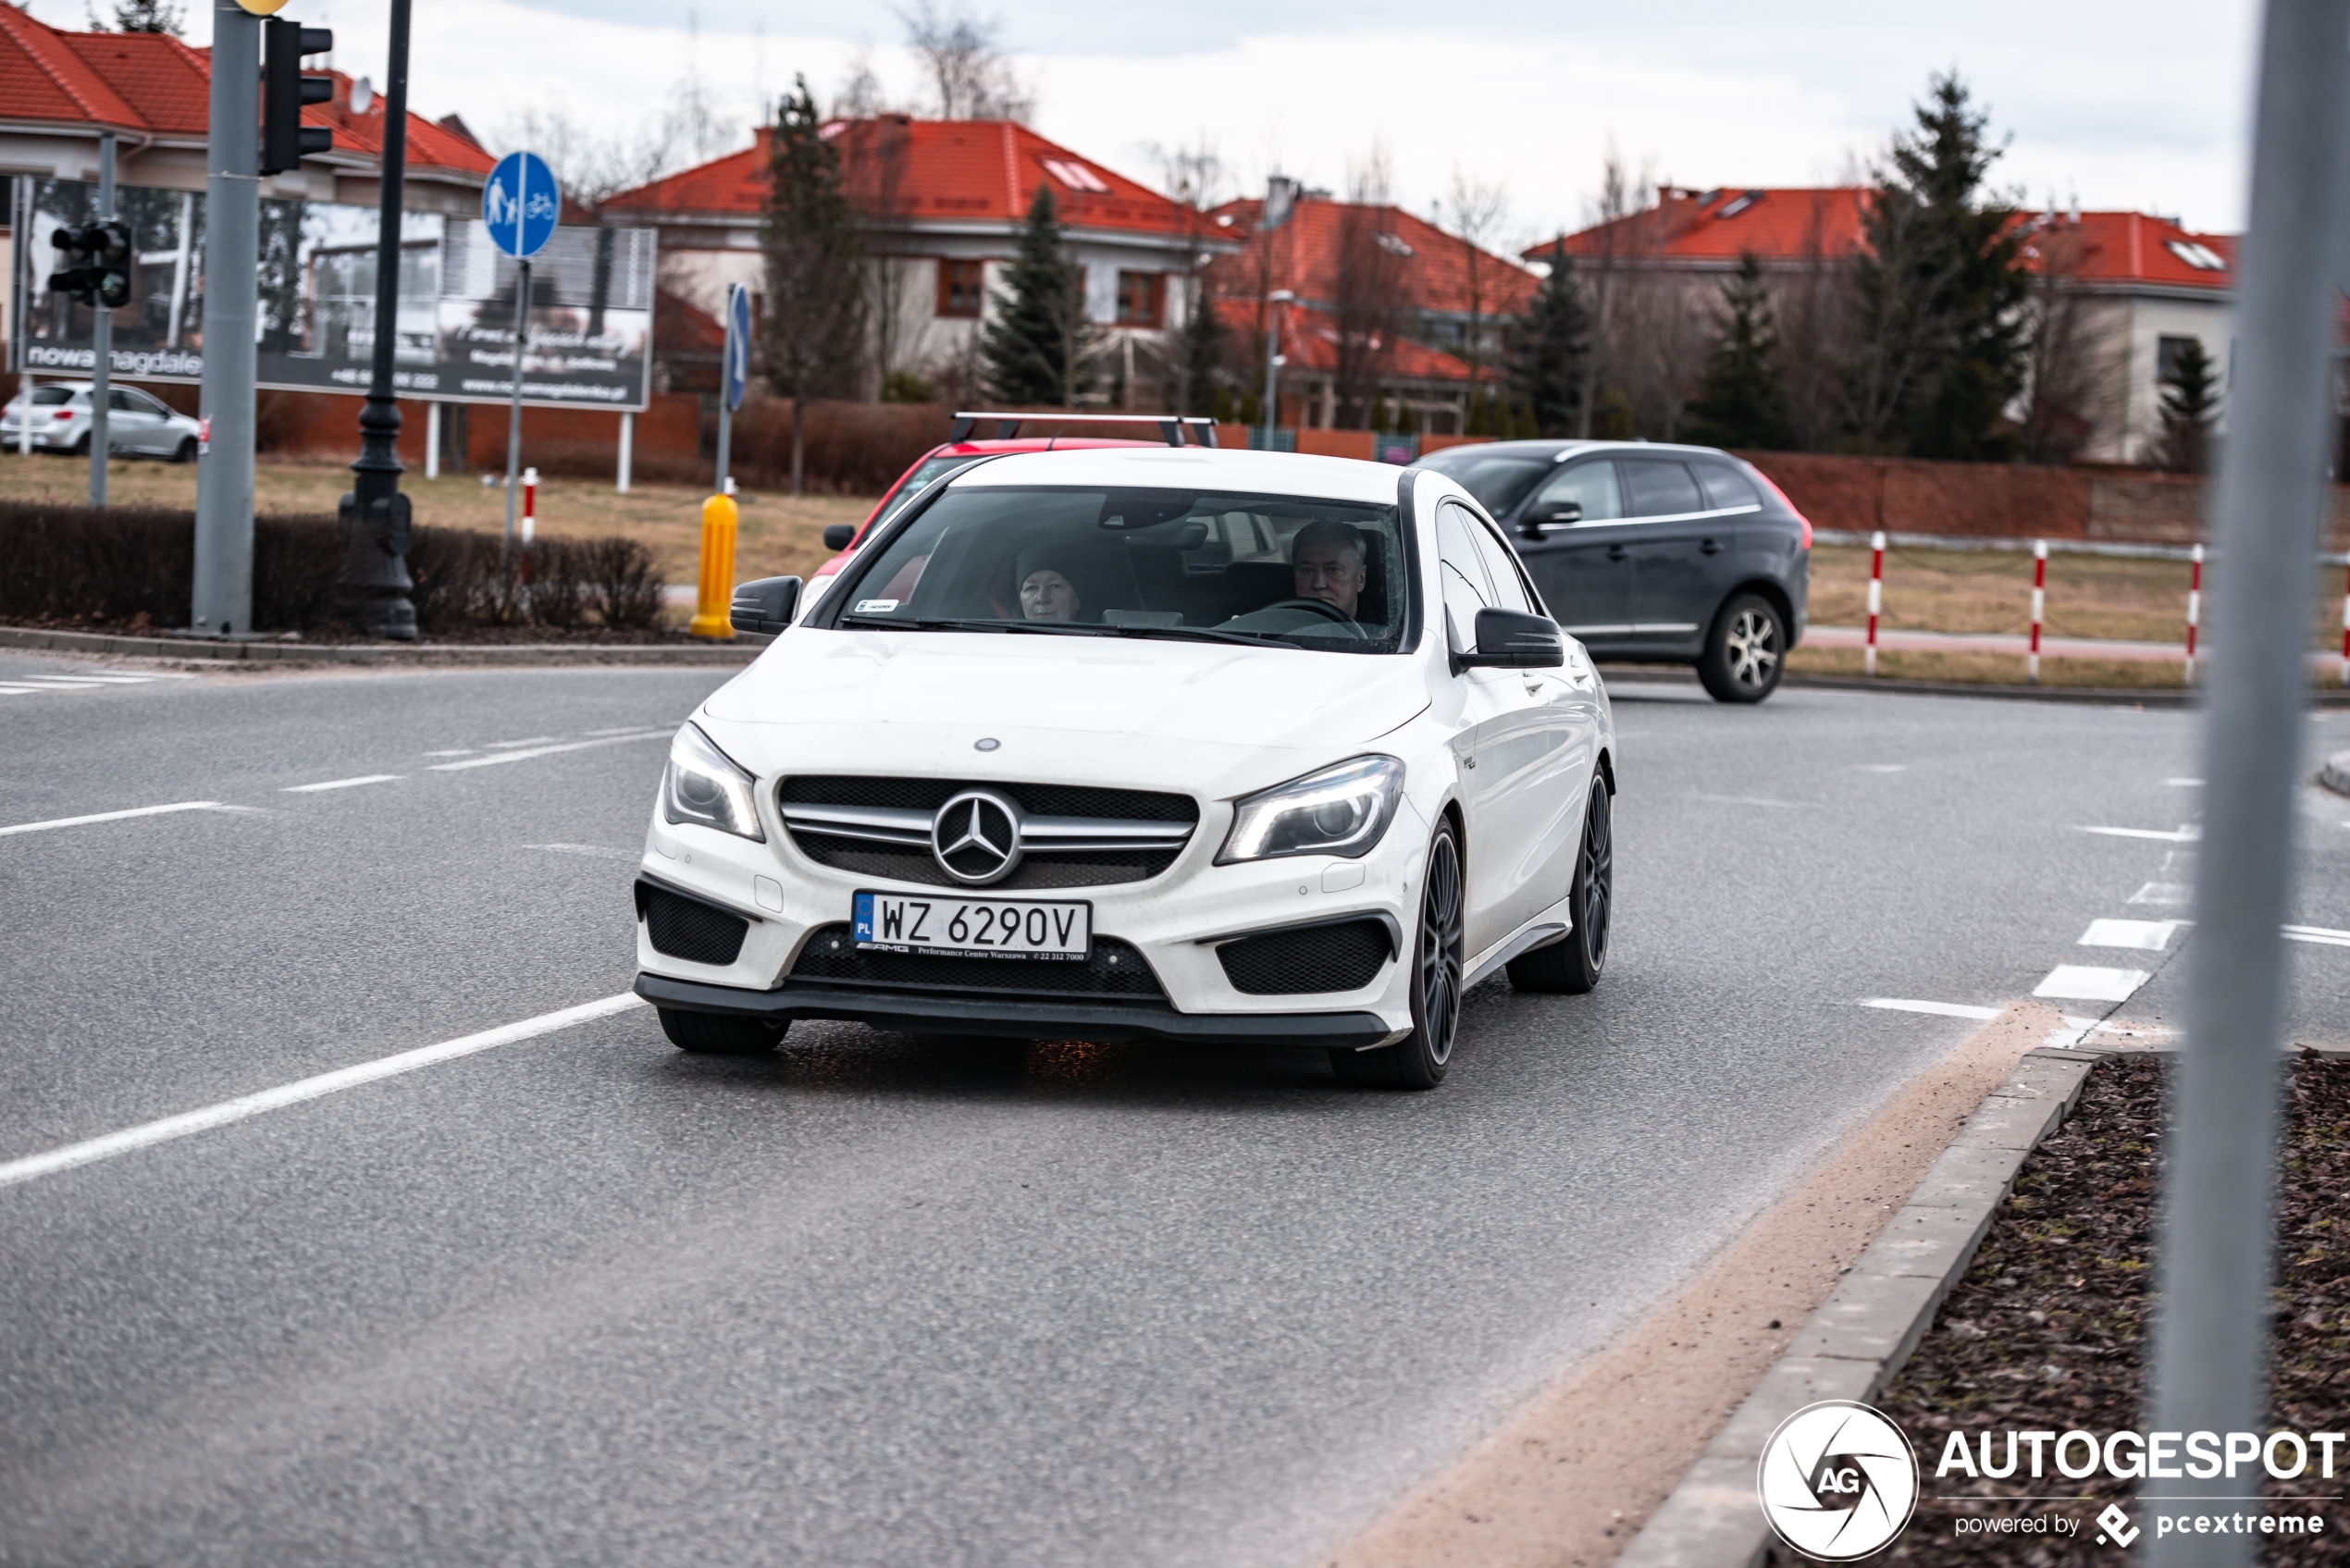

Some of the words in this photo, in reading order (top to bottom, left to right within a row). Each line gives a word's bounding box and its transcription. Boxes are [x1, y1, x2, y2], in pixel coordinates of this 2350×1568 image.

[857, 922, 872, 935] PL
[883, 900, 932, 942] WZ
[948, 905, 1076, 947] 6290V
[873, 945, 909, 953] AMG
[918, 946, 963, 957] Performance
[964, 950, 989, 958] Center
[990, 951, 1027, 959] Warszawa
[1066, 953, 1084, 961] 7000
